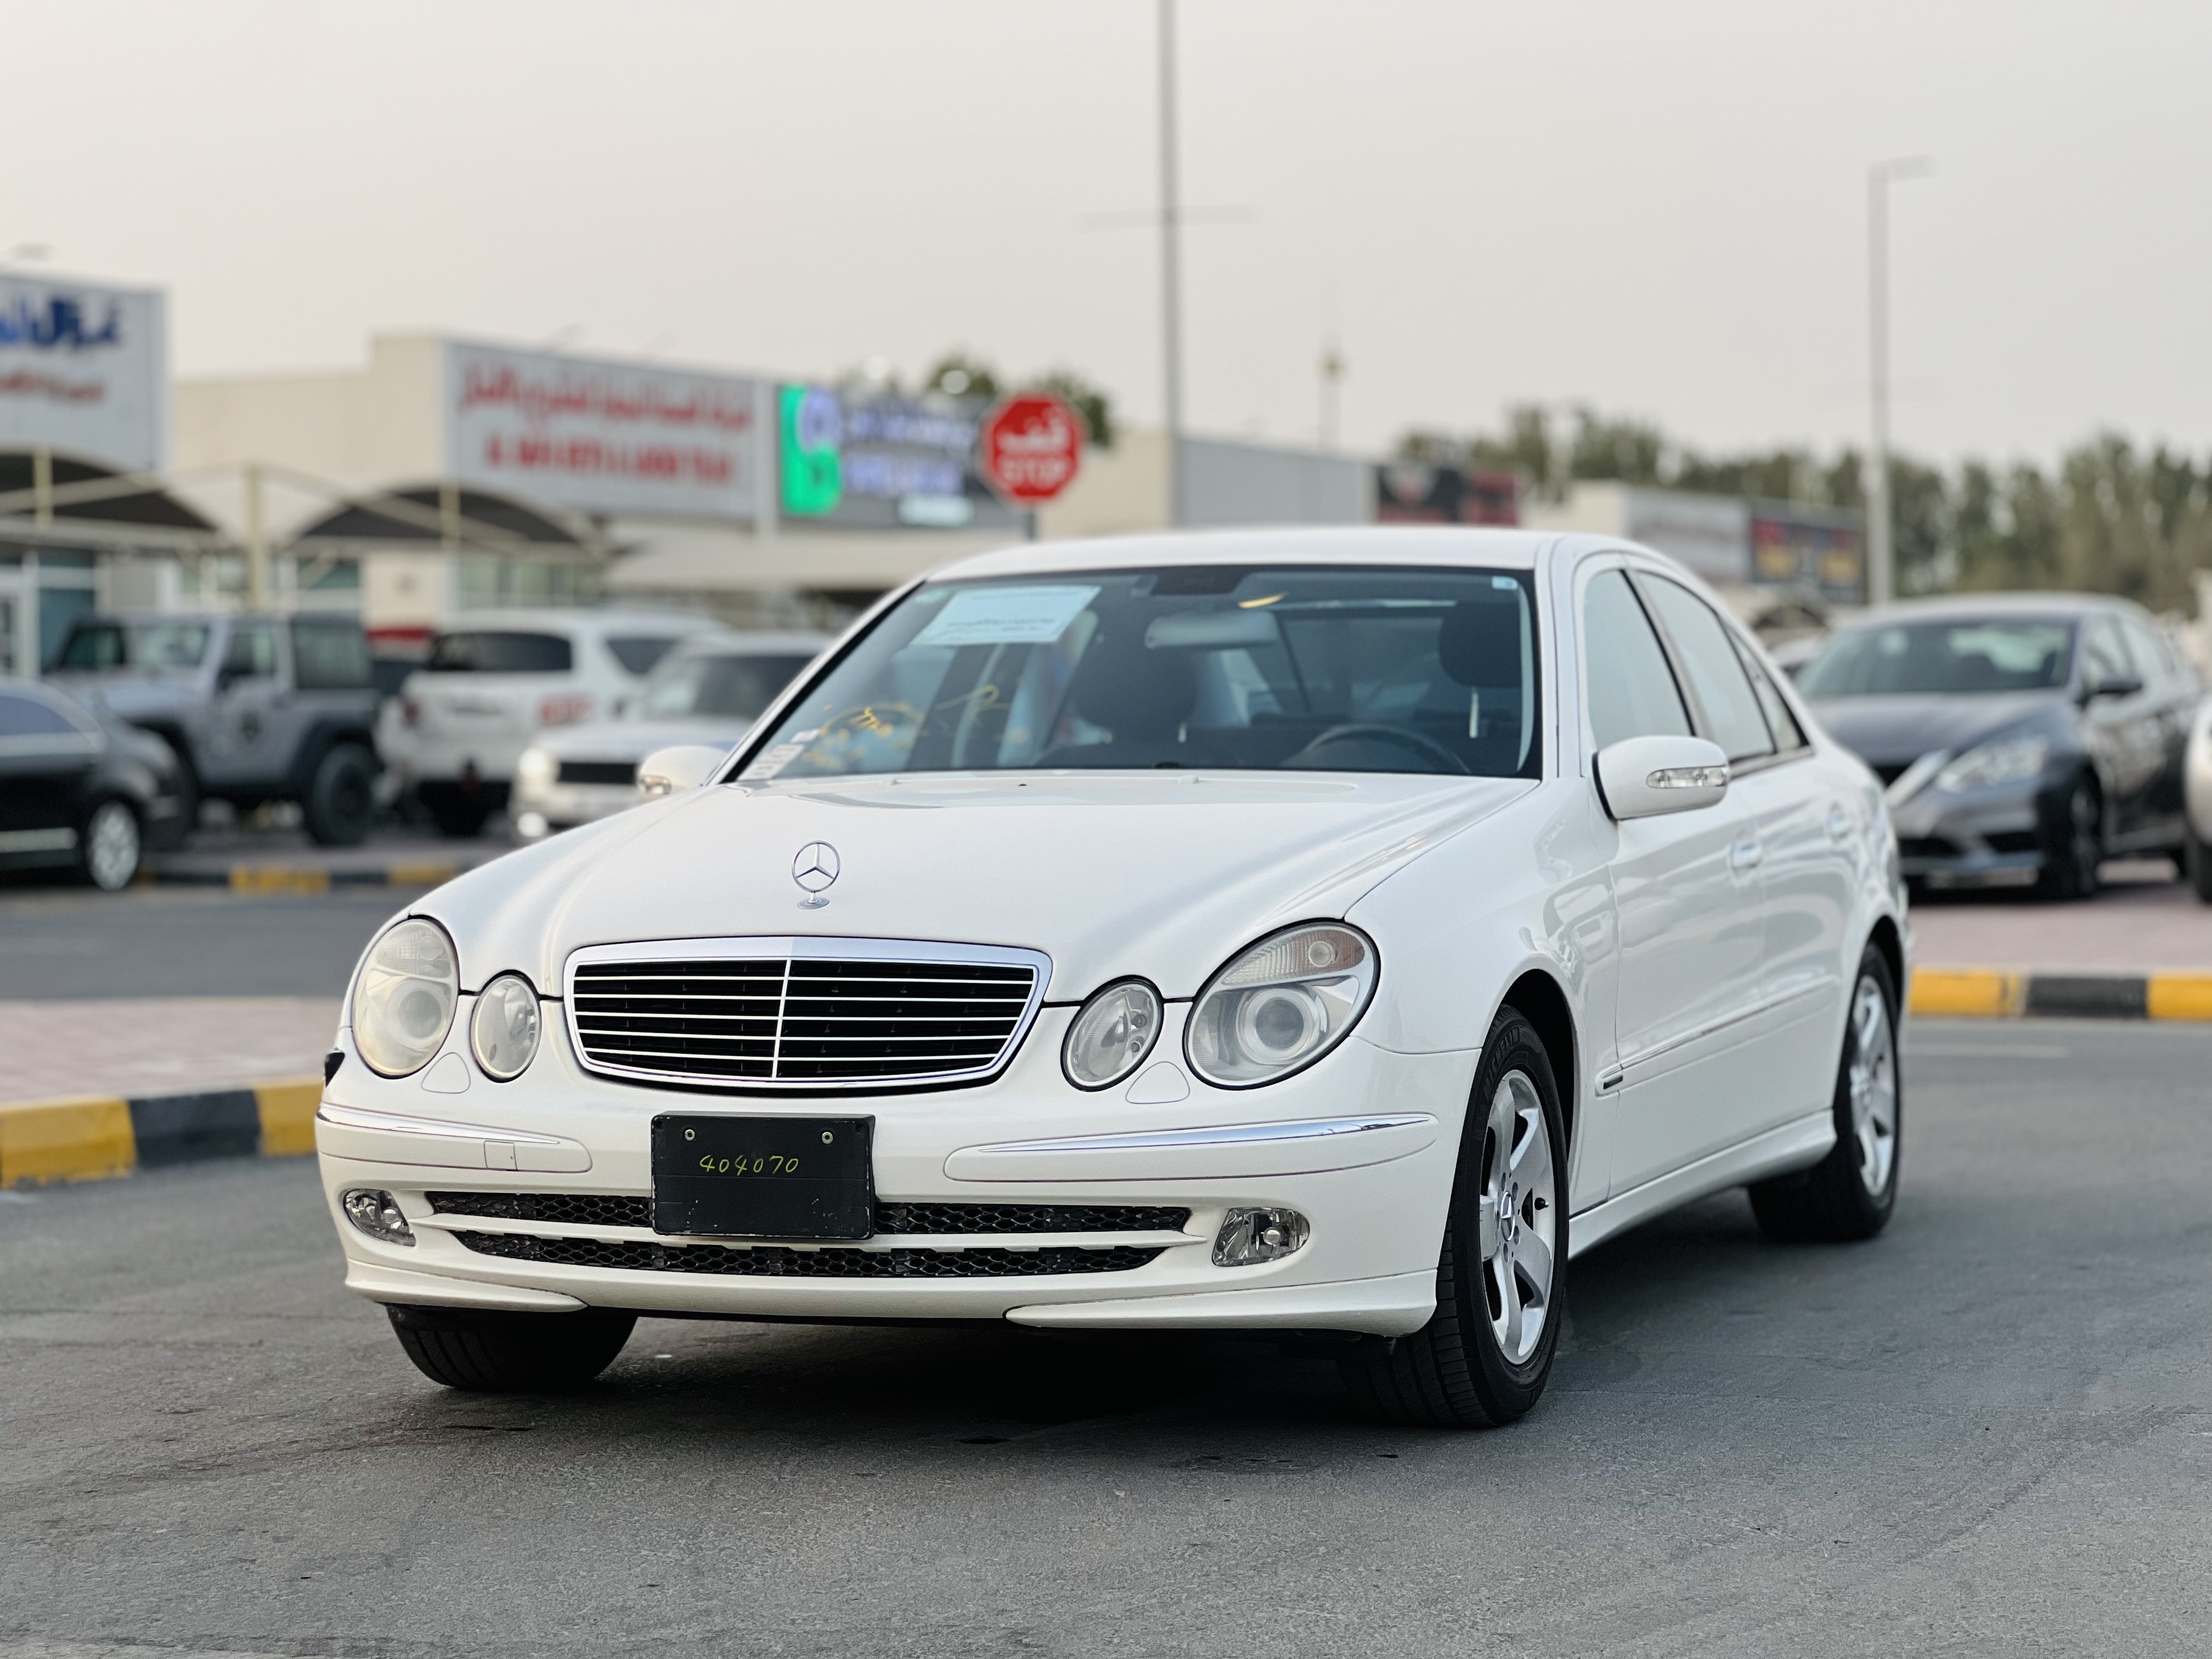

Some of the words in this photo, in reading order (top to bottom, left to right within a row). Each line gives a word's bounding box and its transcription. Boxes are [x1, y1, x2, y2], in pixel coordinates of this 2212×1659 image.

[999, 456, 1068, 486] STOP
[1483, 1026, 1520, 1101] MICHELIN
[699, 1154, 799, 1176] 404070
